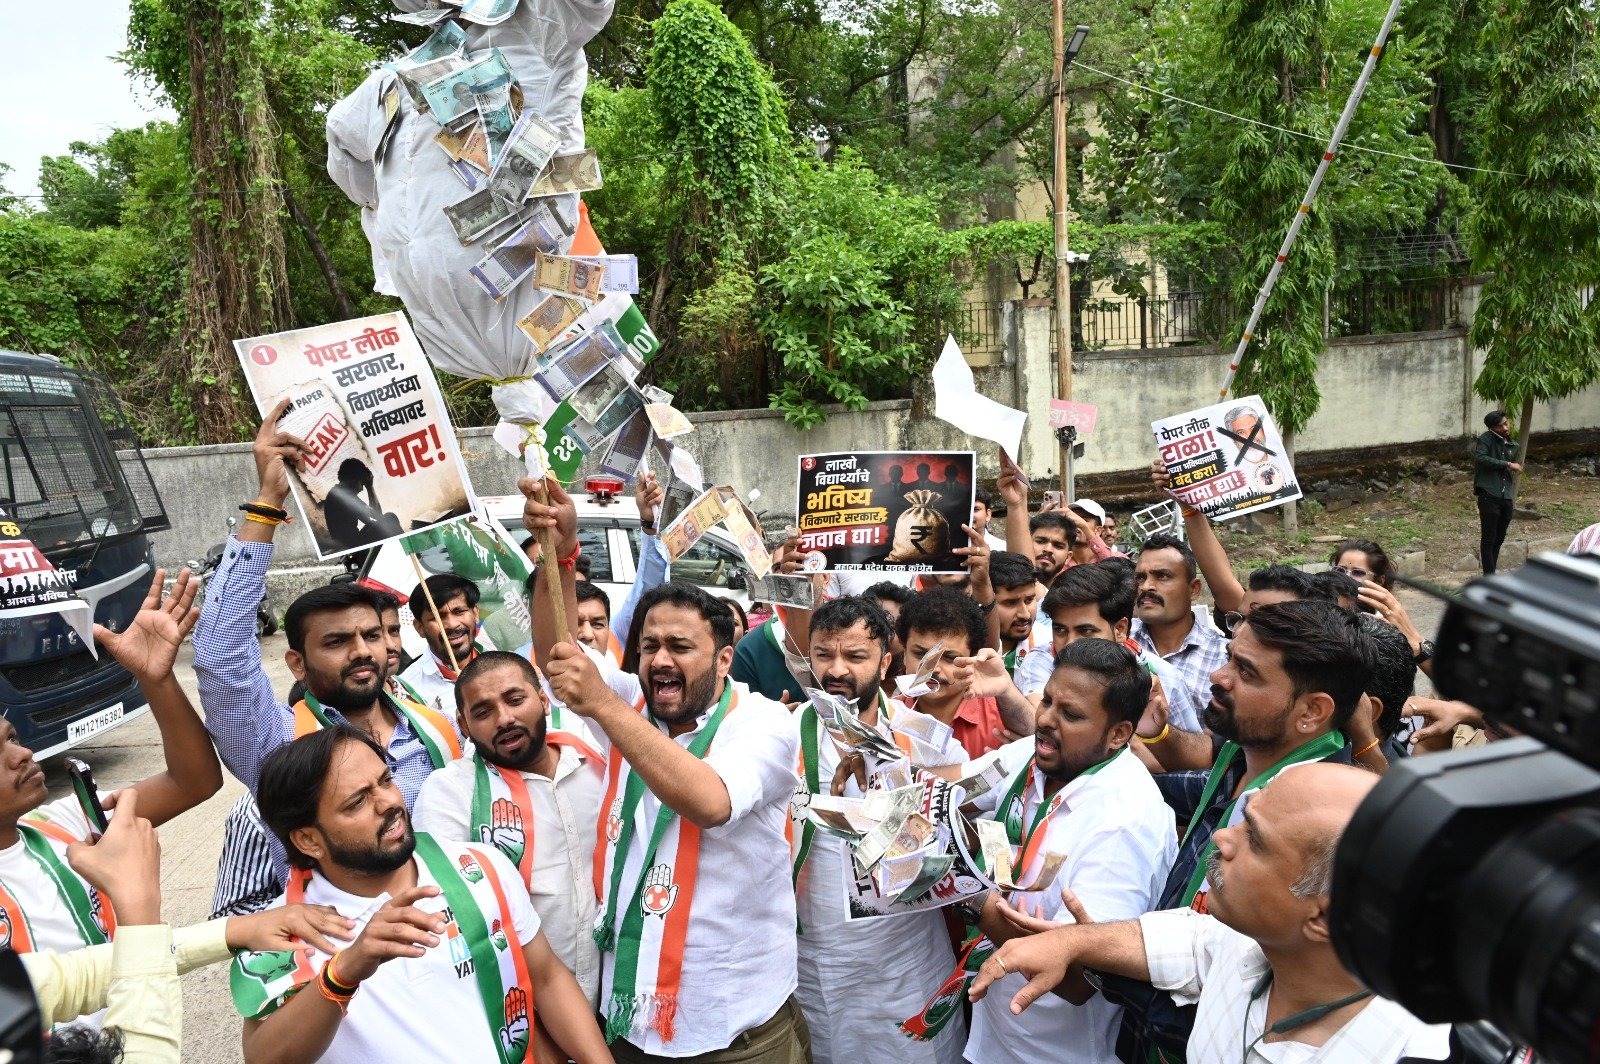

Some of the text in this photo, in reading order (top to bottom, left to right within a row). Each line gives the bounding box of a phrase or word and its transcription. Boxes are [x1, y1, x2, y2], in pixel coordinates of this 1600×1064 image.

[257, 346, 269, 363] 1
[304, 326, 400, 367] पेपर लीक
[332, 352, 405, 388] सरकार,
[295, 389, 325, 408] PAPER
[360, 399, 427, 438] भविष्यावर
[1161, 417, 1210, 441] पेपर लीक
[301, 420, 343, 468] LEAK
[376, 423, 446, 478] वार!
[1159, 430, 1217, 463] टाळा!
[805, 458, 813, 469] 3
[825, 456, 857, 472] लाखो
[1174, 473, 1193, 485] बंद
[1192, 463, 1219, 480] करा!
[807, 485, 873, 510] भविष्य
[804, 511, 883, 527] विकणारे सरकार,
[801, 527, 880, 548] जवाब द्या!
[38, 591, 68, 601] भविष्य
[75, 708, 122, 738] MH12YH6382
